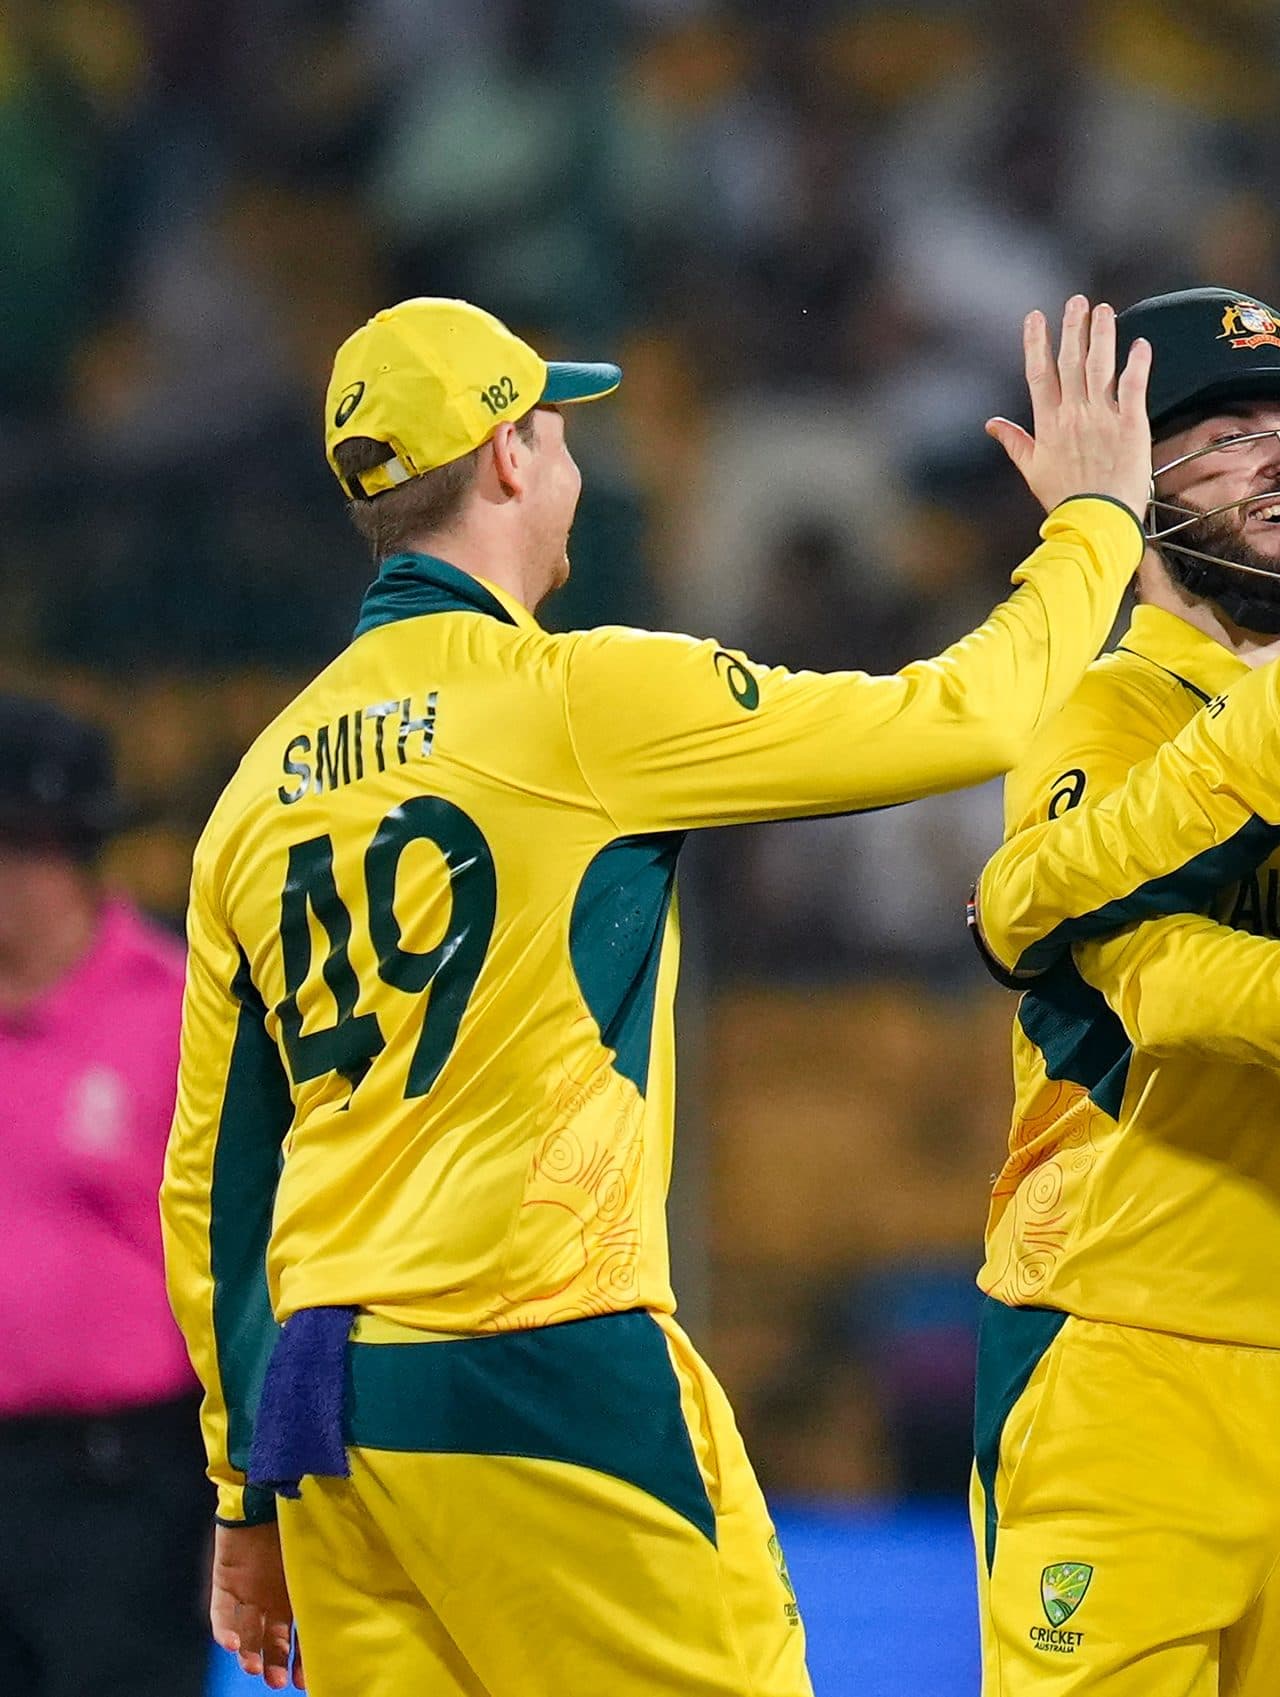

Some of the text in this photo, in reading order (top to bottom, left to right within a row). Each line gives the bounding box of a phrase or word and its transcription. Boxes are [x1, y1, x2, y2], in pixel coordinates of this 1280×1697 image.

[481, 376, 519, 415] 182
[278, 691, 438, 805] SMITH
[276, 795, 497, 1111] 49
[1029, 1626, 1084, 1646] CRICKET
[1034, 1642, 1074, 1653] AUSTRALIA
